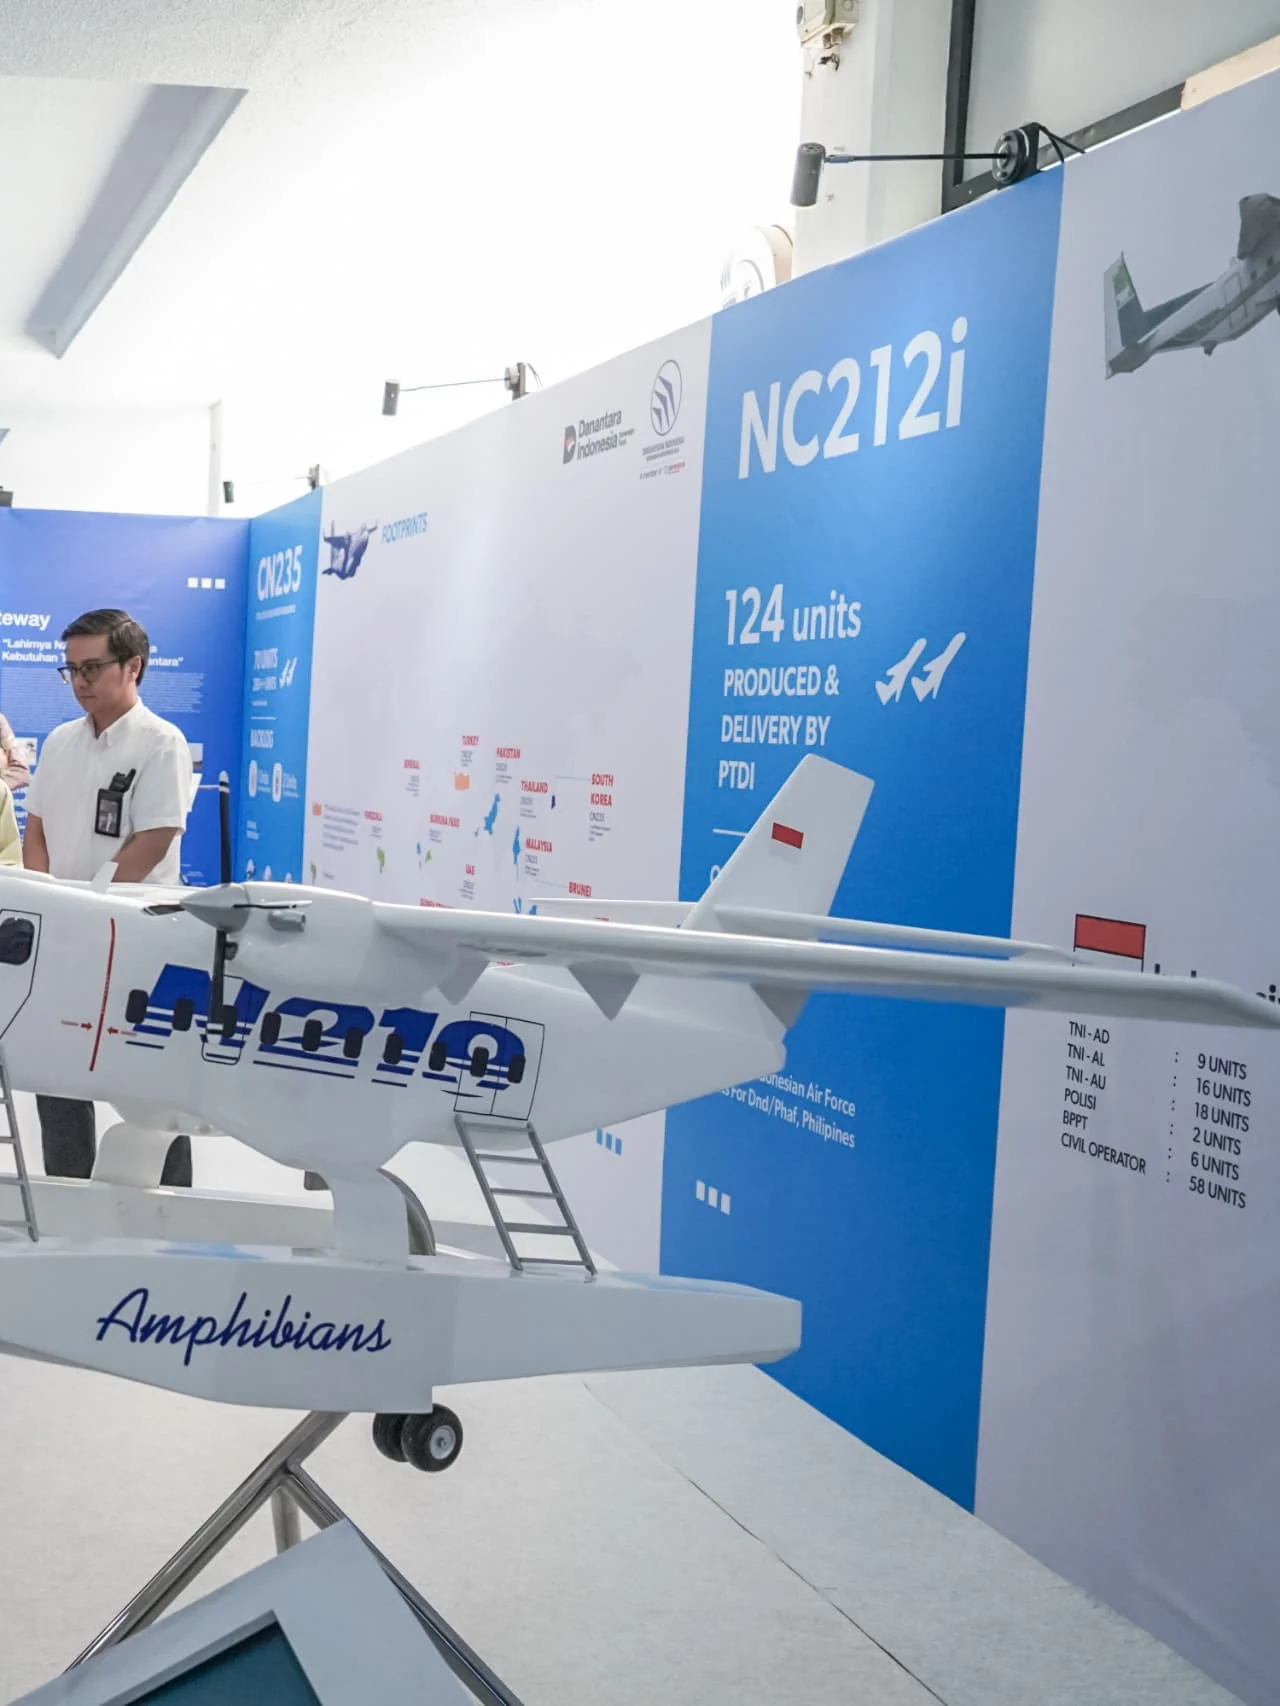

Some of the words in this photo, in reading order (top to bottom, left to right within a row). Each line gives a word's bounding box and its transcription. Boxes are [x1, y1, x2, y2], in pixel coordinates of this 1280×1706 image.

[738, 317, 968, 479] NC212i
[579, 410, 622, 438] Danantara
[577, 431, 618, 460] Indonesia
[257, 544, 303, 601] CN235
[725, 583, 785, 645] 124
[792, 590, 862, 642] units
[724, 665, 821, 697] PRODUCED
[825, 664, 840, 696] &
[721, 714, 803, 745] DELIVERY
[805, 716, 831, 746] BY
[521, 780, 548, 794] THAILAND
[591, 773, 614, 787] SOUTH
[718, 760, 755, 790] PTDI
[590, 793, 612, 807] KOREA
[525, 838, 553, 853] MALAYSIA
[568, 881, 593, 898] BRUNEI
[1069, 1021, 1087, 1038] TNI
[1093, 1027, 1110, 1044] AD
[1197, 1053, 1206, 1070] 9
[1209, 1056, 1247, 1080] UNITS
[1067, 1043, 1085, 1061] TNI
[1091, 1050, 1105, 1067] AL
[1196, 1077, 1210, 1096] 16
[1213, 1081, 1252, 1107] UNITS
[806, 1082, 822, 1104] Air
[824, 1088, 856, 1118] Force
[1066, 1065, 1083, 1084] TNI
[1090, 1073, 1107, 1090] AU
[1194, 1102, 1209, 1121] 18
[1211, 1106, 1250, 1132] UNITS
[802, 1110, 856, 1149] Philipines
[1064, 1088, 1097, 1110] POLISI
[1192, 1127, 1201, 1144] 2
[1203, 1130, 1242, 1156] UNITS
[1062, 1110, 1089, 1130] BPPT
[1190, 1151, 1199, 1167] 6
[1201, 1154, 1240, 1181] UNITS
[1060, 1132, 1087, 1154] CIVIL
[1088, 1141, 1147, 1175] OPERATOR
[1188, 1175, 1205, 1195] 58
[1207, 1180, 1247, 1209] UNITS
[96, 1288, 392, 1366] Amphibians
